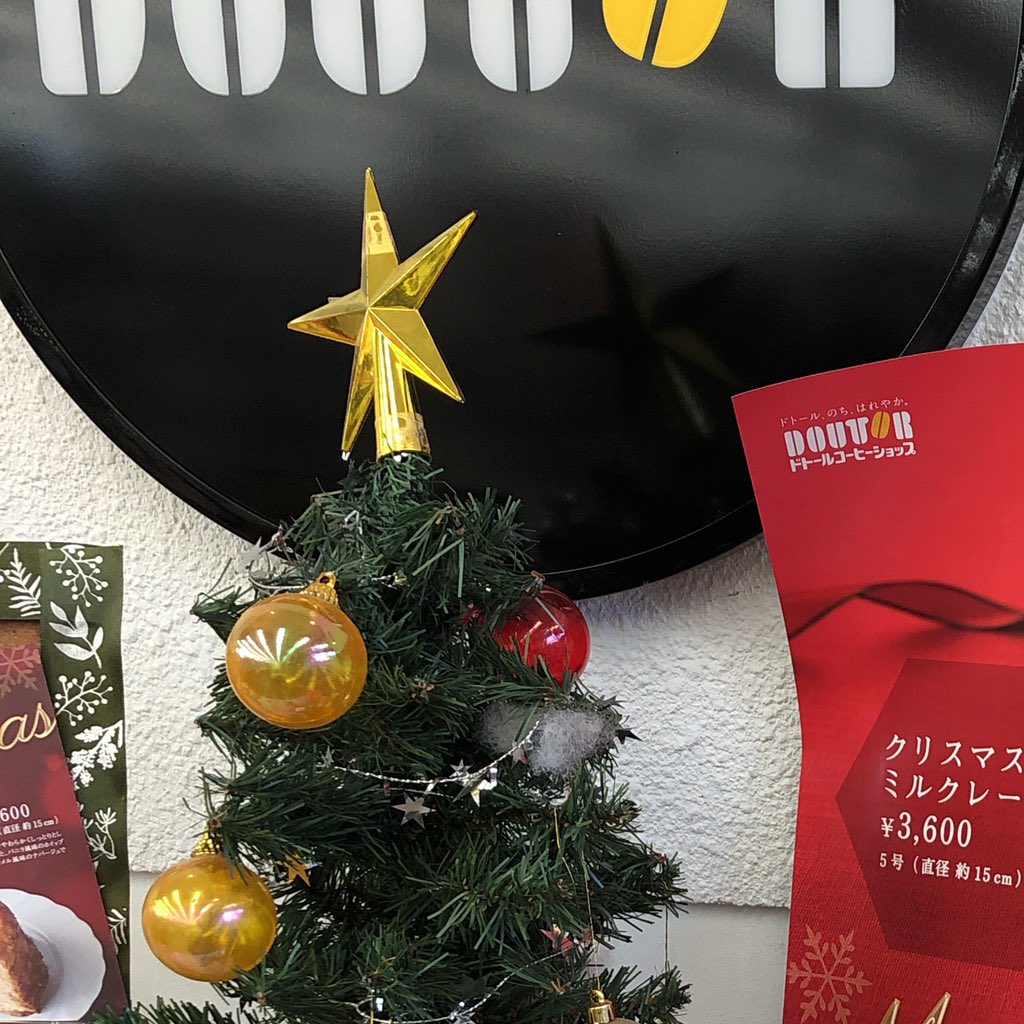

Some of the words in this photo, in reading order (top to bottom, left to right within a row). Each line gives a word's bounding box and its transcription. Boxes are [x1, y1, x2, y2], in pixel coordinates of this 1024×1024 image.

[780, 397, 909, 427] ドトール、のち、はれやか。
[784, 411, 914, 457] DOUTOR
[789, 442, 916, 472] ドトールコーヒーショップ
[886, 734, 1024, 773] クリスマス
[881, 812, 973, 847] ¥3,600
